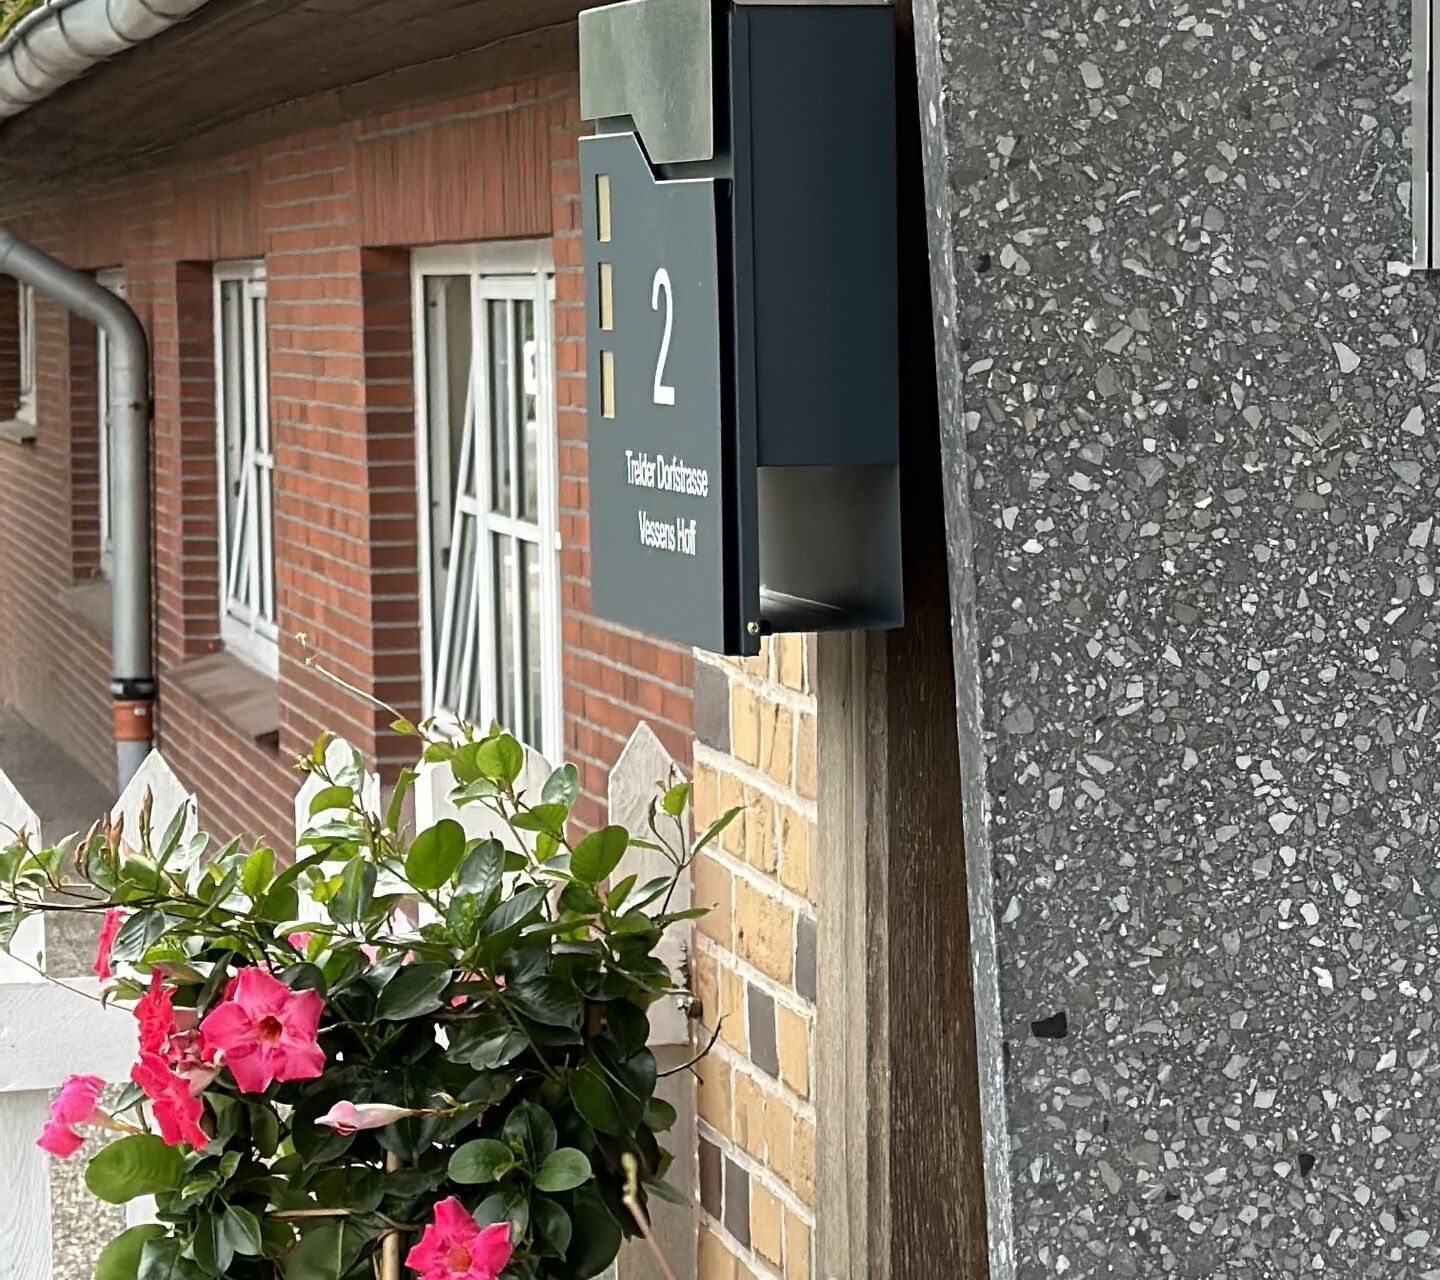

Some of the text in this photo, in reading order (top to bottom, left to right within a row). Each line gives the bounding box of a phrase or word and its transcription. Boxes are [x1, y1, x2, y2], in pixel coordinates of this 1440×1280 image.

[651, 267, 676, 405] 2
[625, 450, 709, 497] Trelder Dorfstrasse
[638, 510, 697, 556] Vessens Hoff
